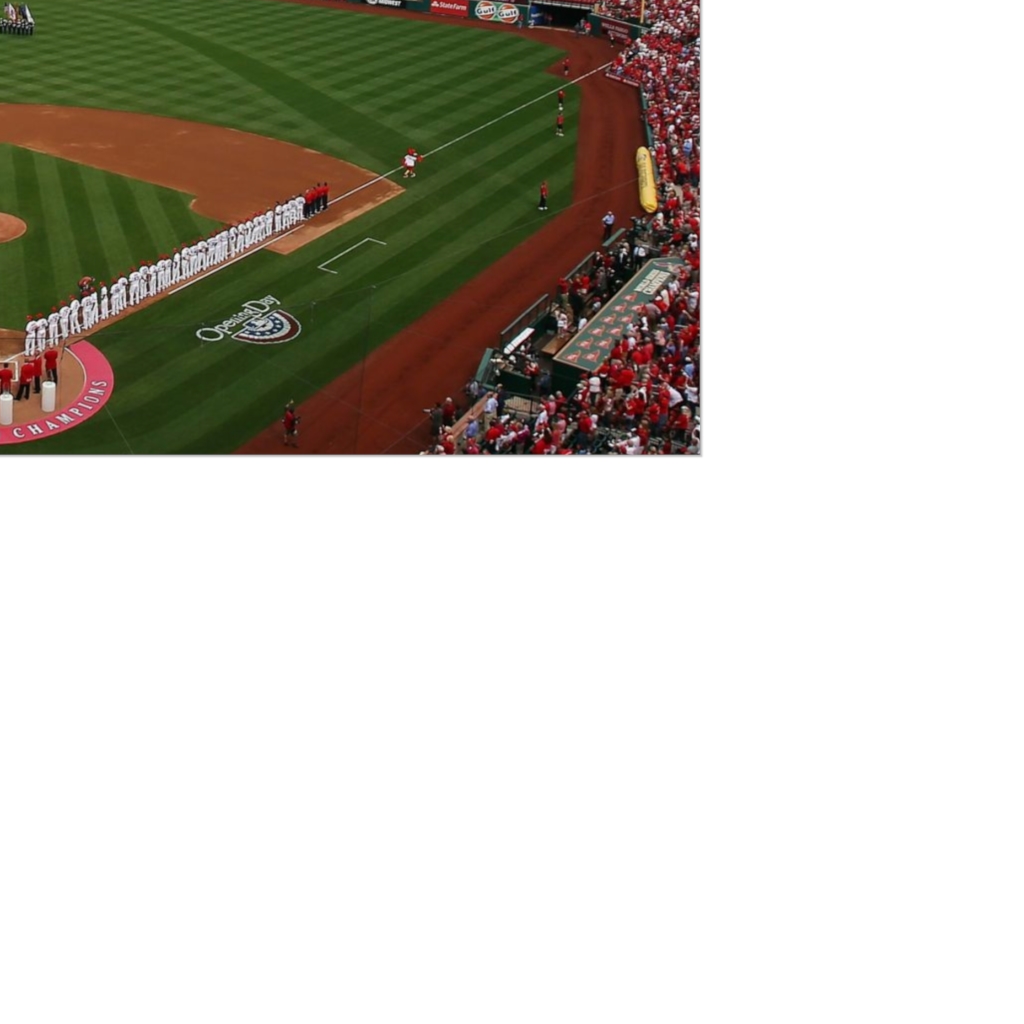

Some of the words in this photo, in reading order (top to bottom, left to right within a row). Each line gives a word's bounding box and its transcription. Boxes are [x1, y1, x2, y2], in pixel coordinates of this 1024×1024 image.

[476, 7, 495, 15] Gulf
[498, 9, 517, 17] Gulf
[196, 308, 263, 341] Opening
[241, 294, 281, 313] Day
[12, 379, 108, 439] CHAMPIONS
